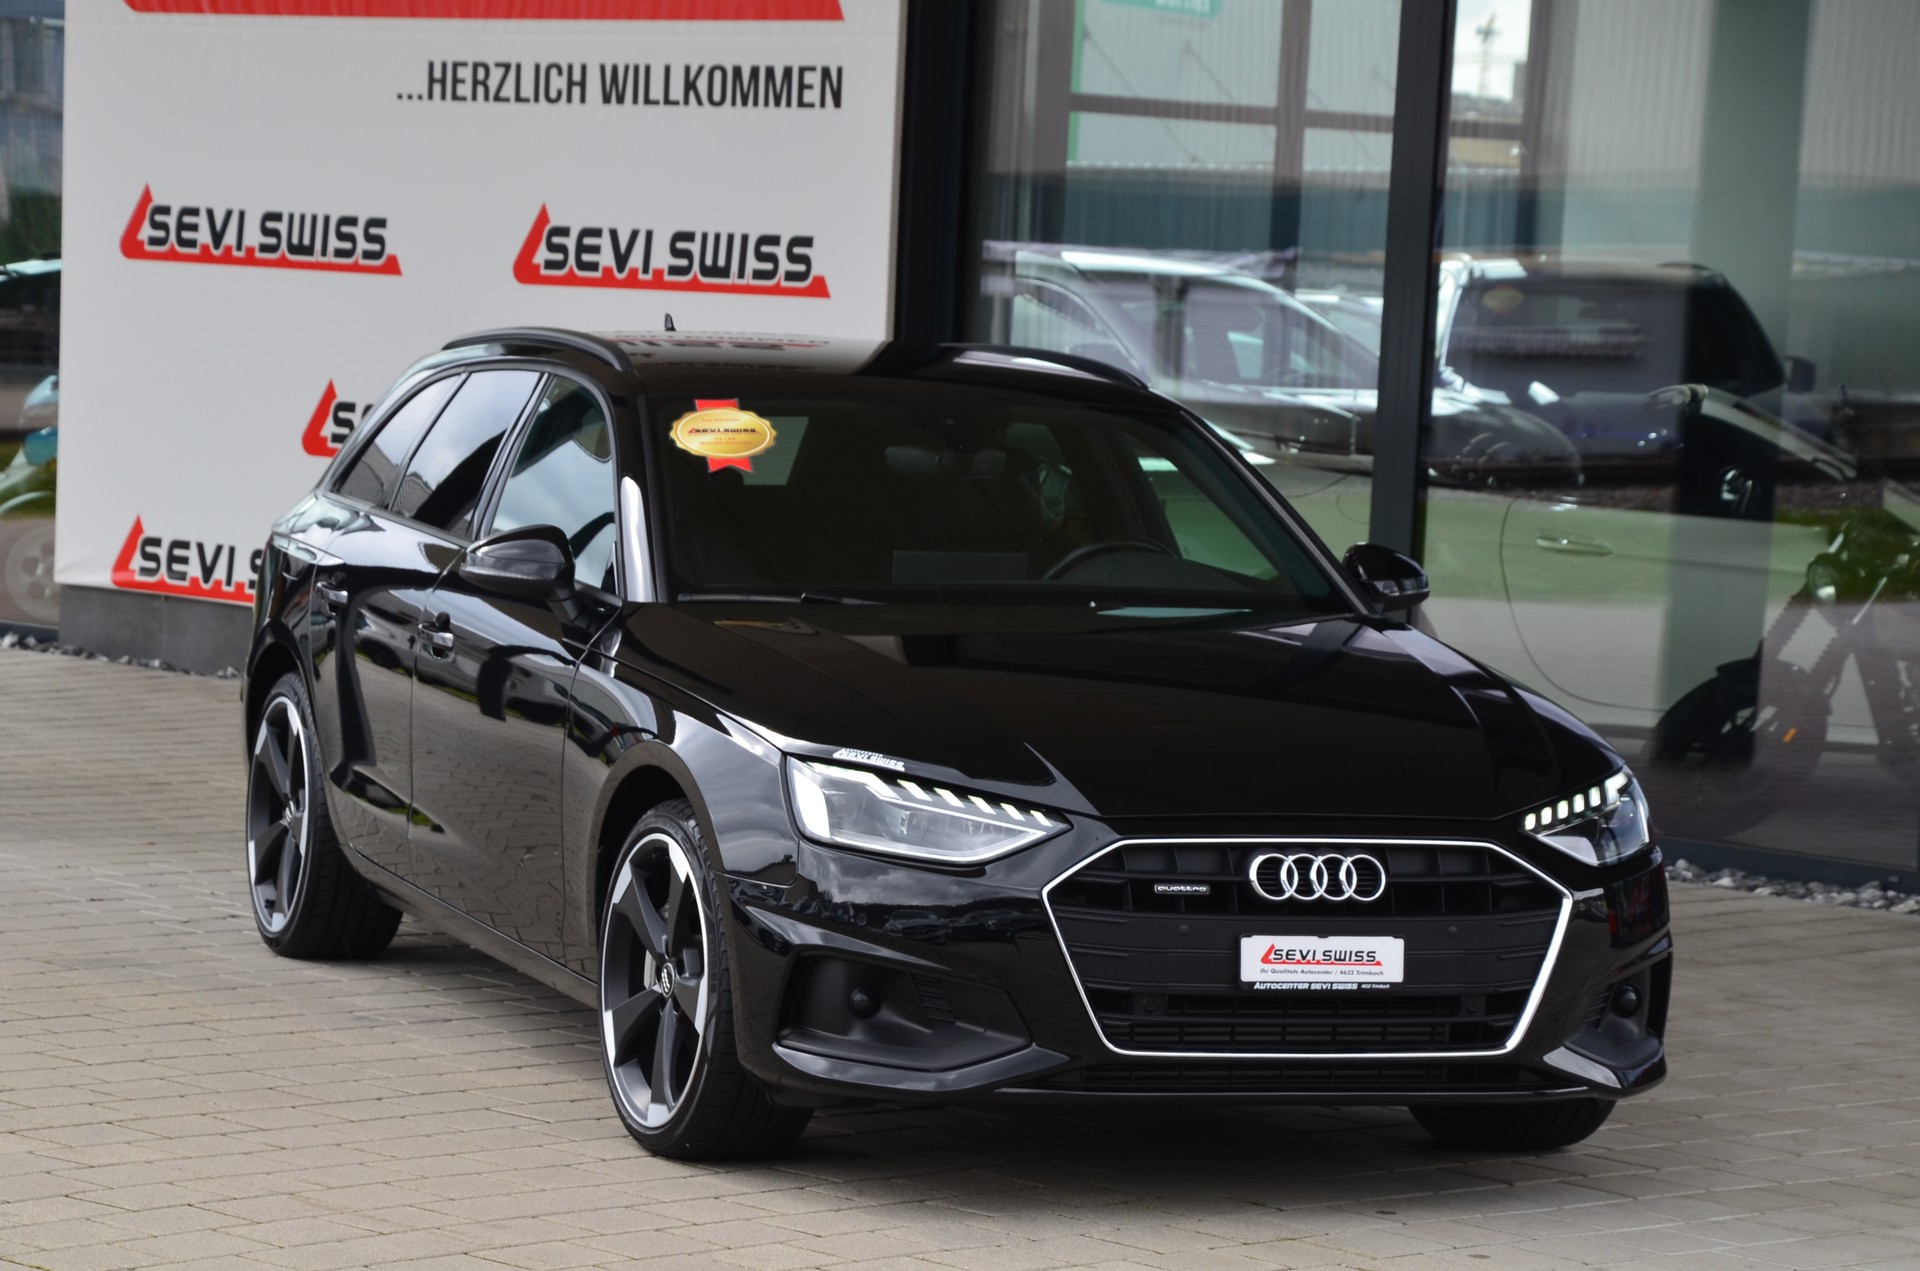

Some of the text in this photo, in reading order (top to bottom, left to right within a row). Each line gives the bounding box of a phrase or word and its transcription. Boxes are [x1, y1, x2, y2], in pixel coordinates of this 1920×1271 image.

[396, 61, 843, 109] ...HERZLICH WILLKOMMEN
[147, 204, 388, 261] SEVI SWISS
[543, 225, 814, 283] SEVI SWISS
[138, 537, 236, 587] SEVI
[1273, 949, 1376, 962] SEVI SWISS
[1254, 982, 1309, 990] AUTOCENTER
